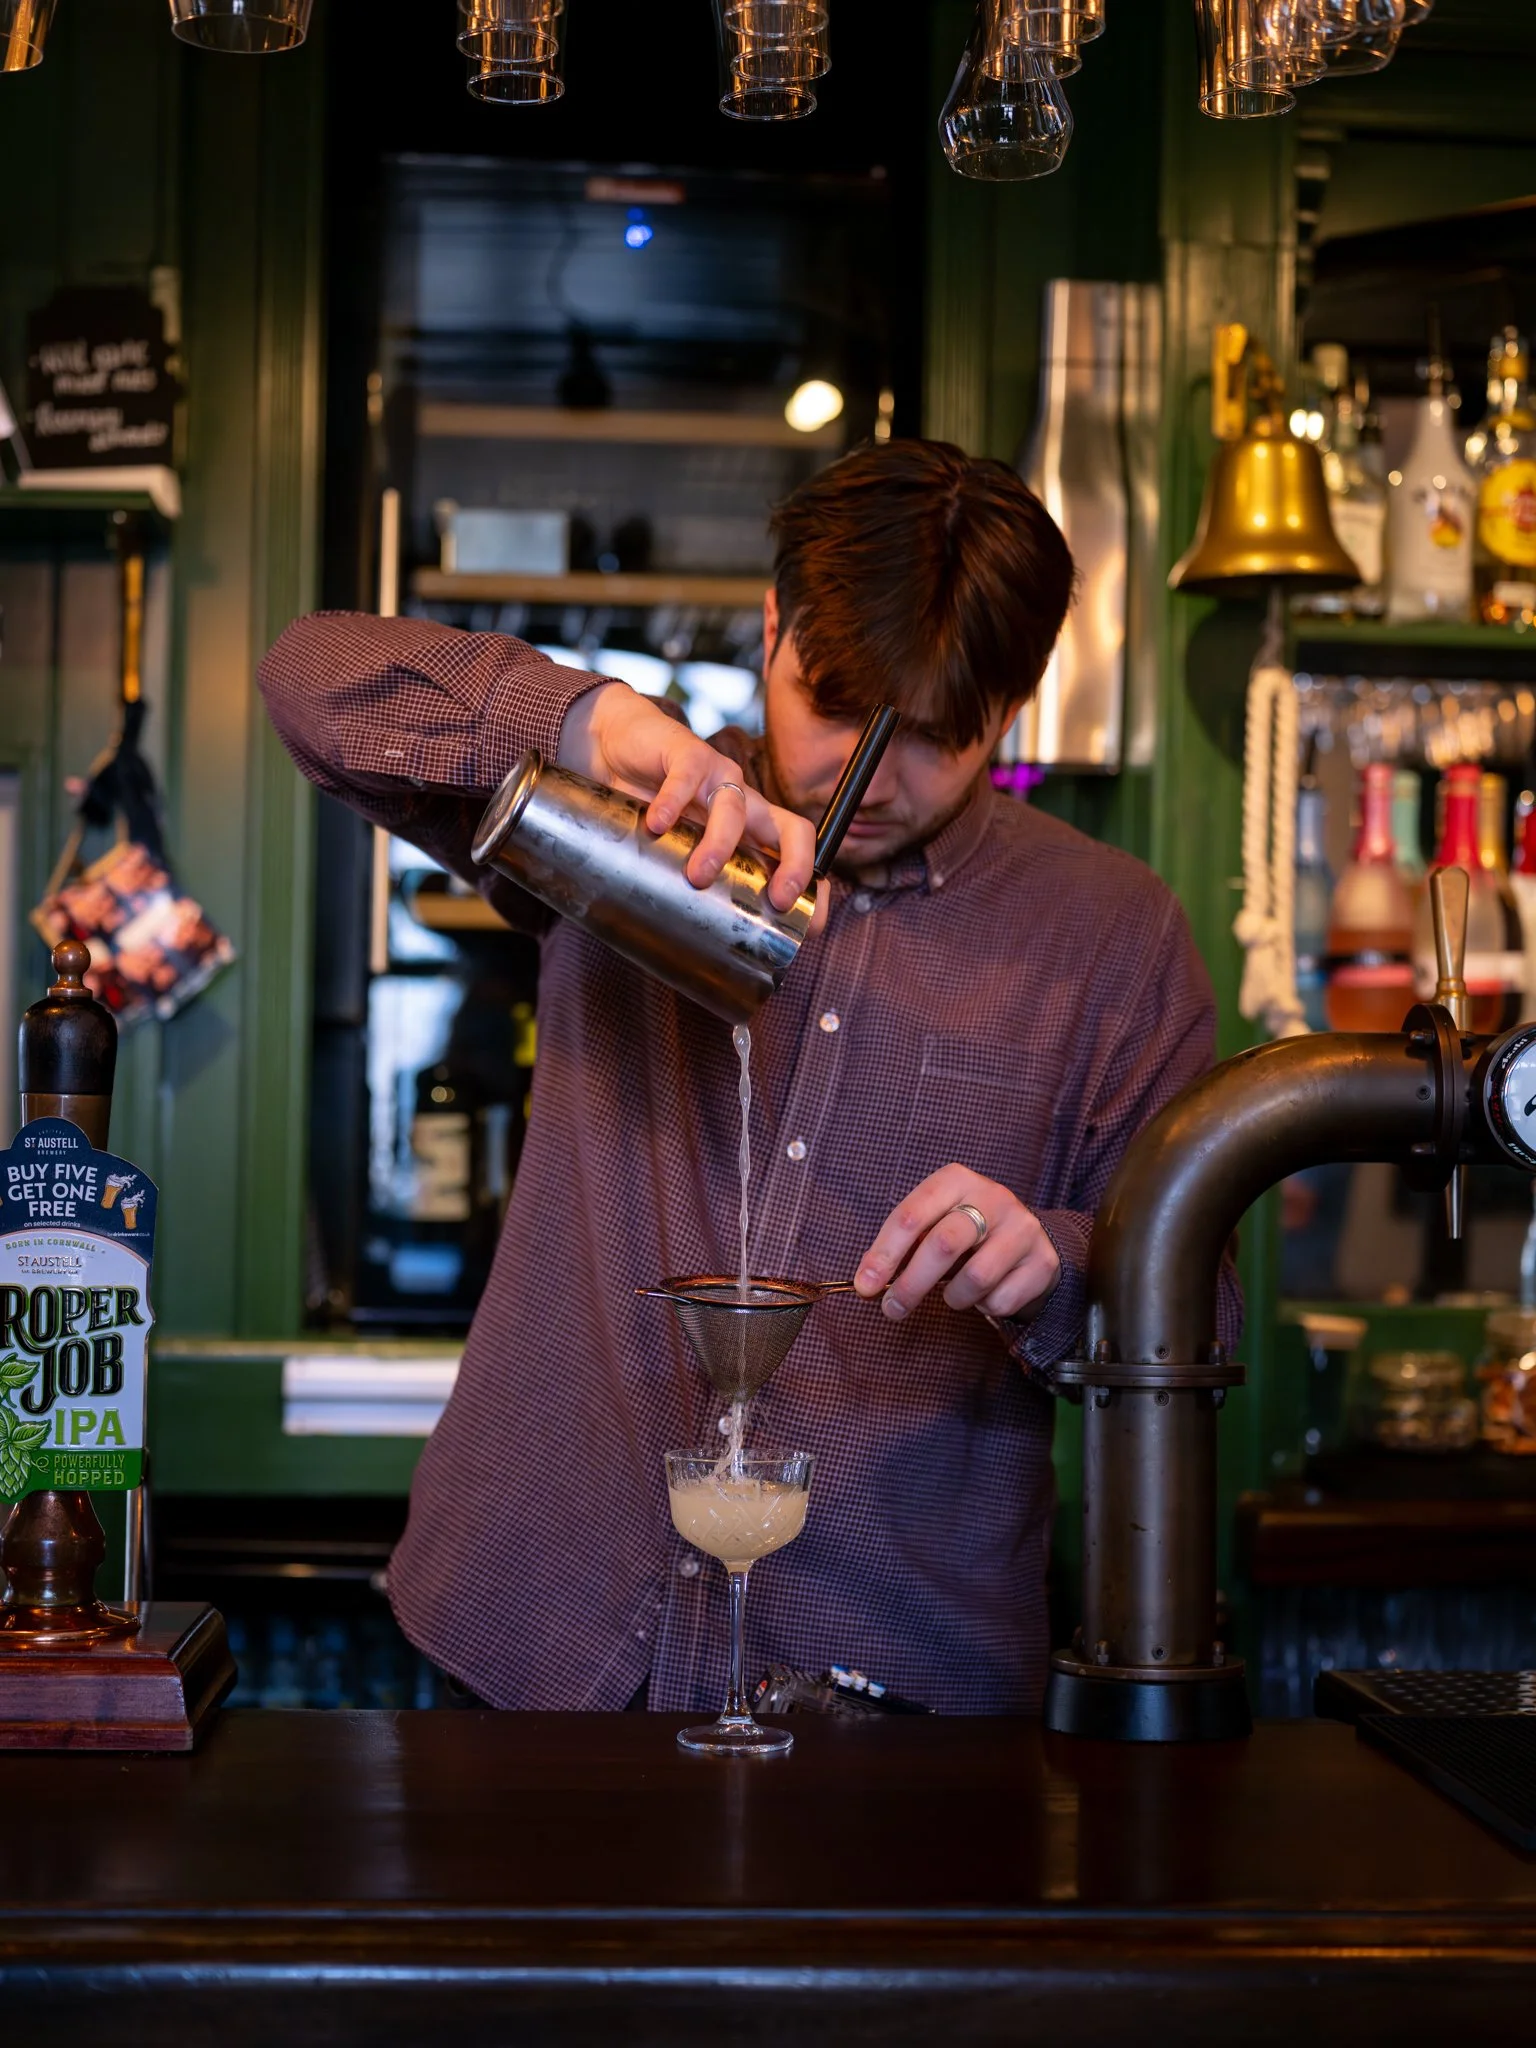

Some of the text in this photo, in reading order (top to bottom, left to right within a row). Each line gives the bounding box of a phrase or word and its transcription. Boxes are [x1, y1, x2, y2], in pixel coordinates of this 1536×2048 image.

[37, 1137, 79, 1149] AUSTELL
[7, 1163, 98, 1183] BUY FIVE
[7, 1182, 98, 1202] GET ONE
[28, 1201, 77, 1217] FREE
[33, 1220, 61, 1228] selected
[61, 1220, 81, 1228] drinks
[5, 1238, 97, 1252] BORN IN CORNWALL
[30, 1255, 83, 1268] AUSTELL
[0, 1284, 146, 1348] ROPER
[20, 1332, 124, 1416] JOB
[54, 1407, 126, 1446] IPA
[53, 1454, 126, 1469] POWERFULLY
[53, 1470, 126, 1486] HOPPED
